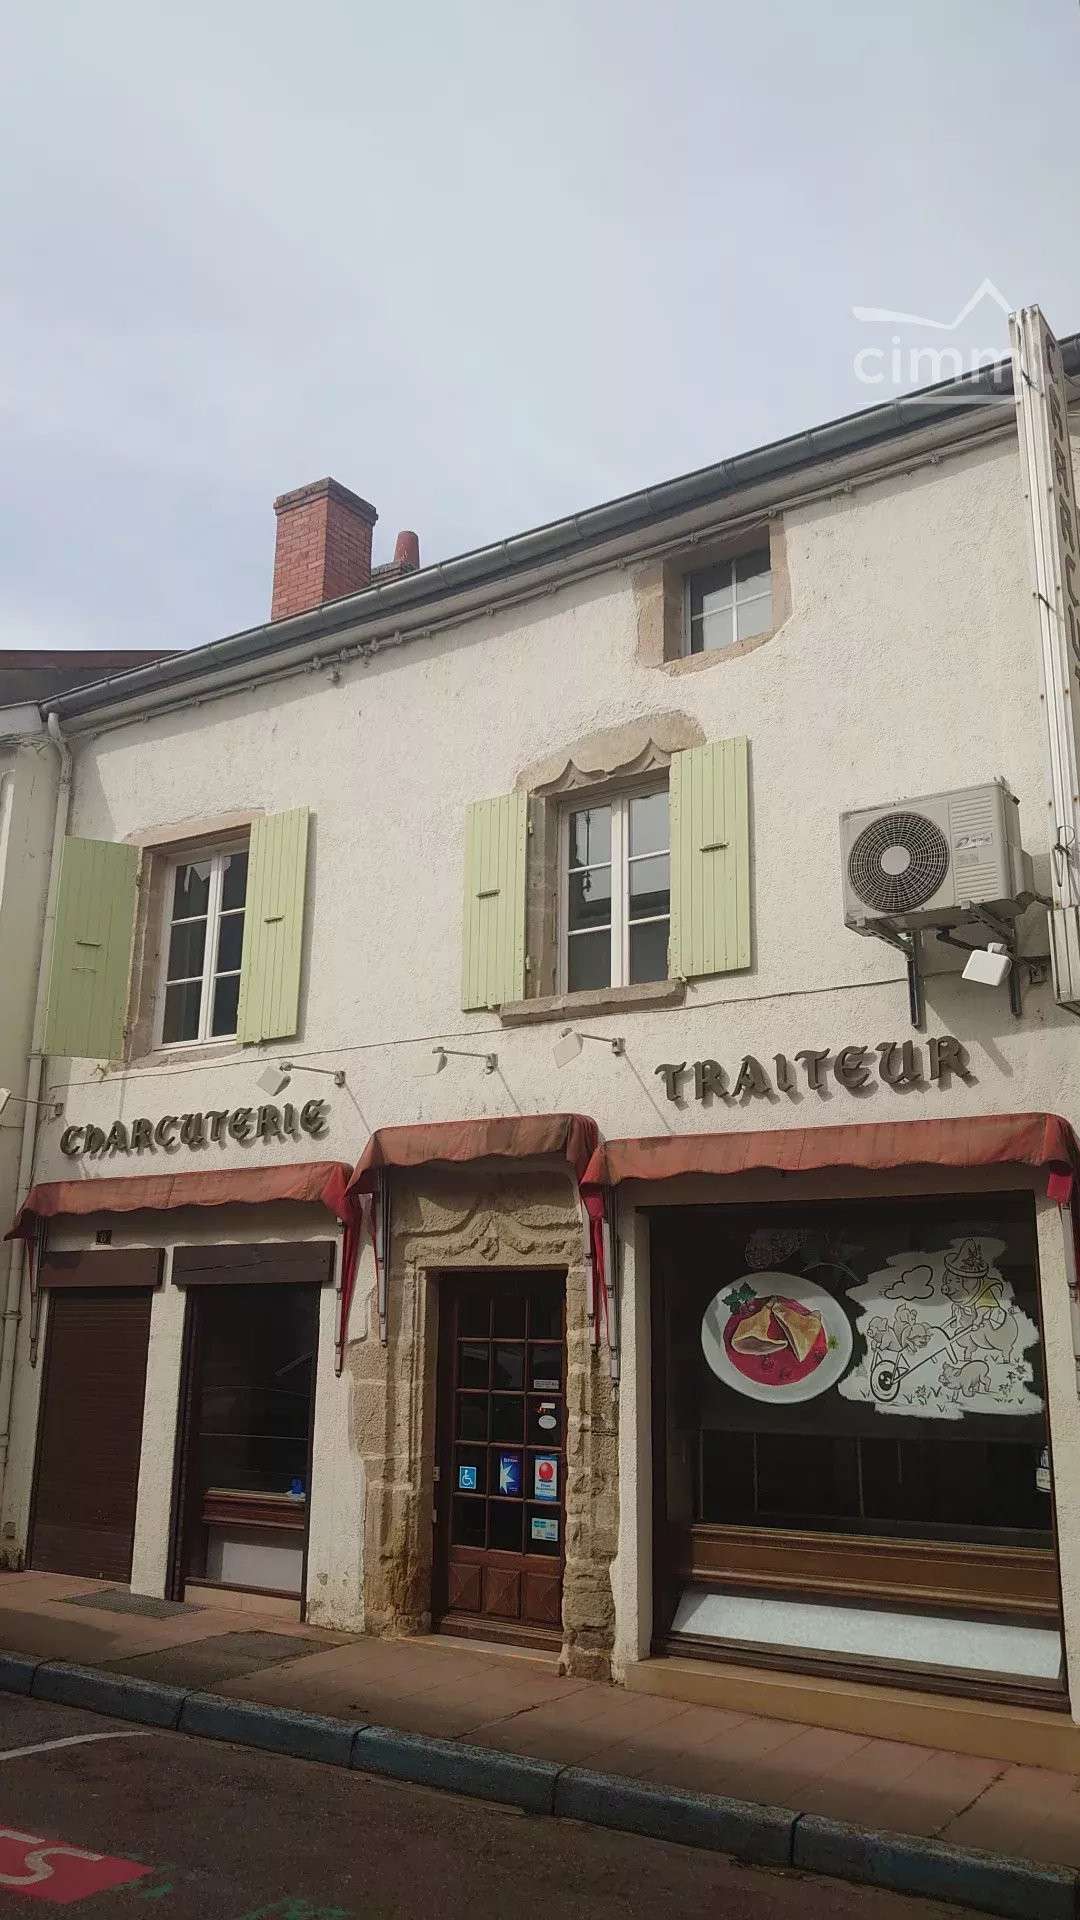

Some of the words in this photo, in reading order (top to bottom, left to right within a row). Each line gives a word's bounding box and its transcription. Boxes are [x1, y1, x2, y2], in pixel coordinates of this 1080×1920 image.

[1046, 333, 1080, 689] CHARCU
[654, 1035, 972, 1101] TRAITEUR
[60, 1099, 326, 1156] CHARCUTERIE
